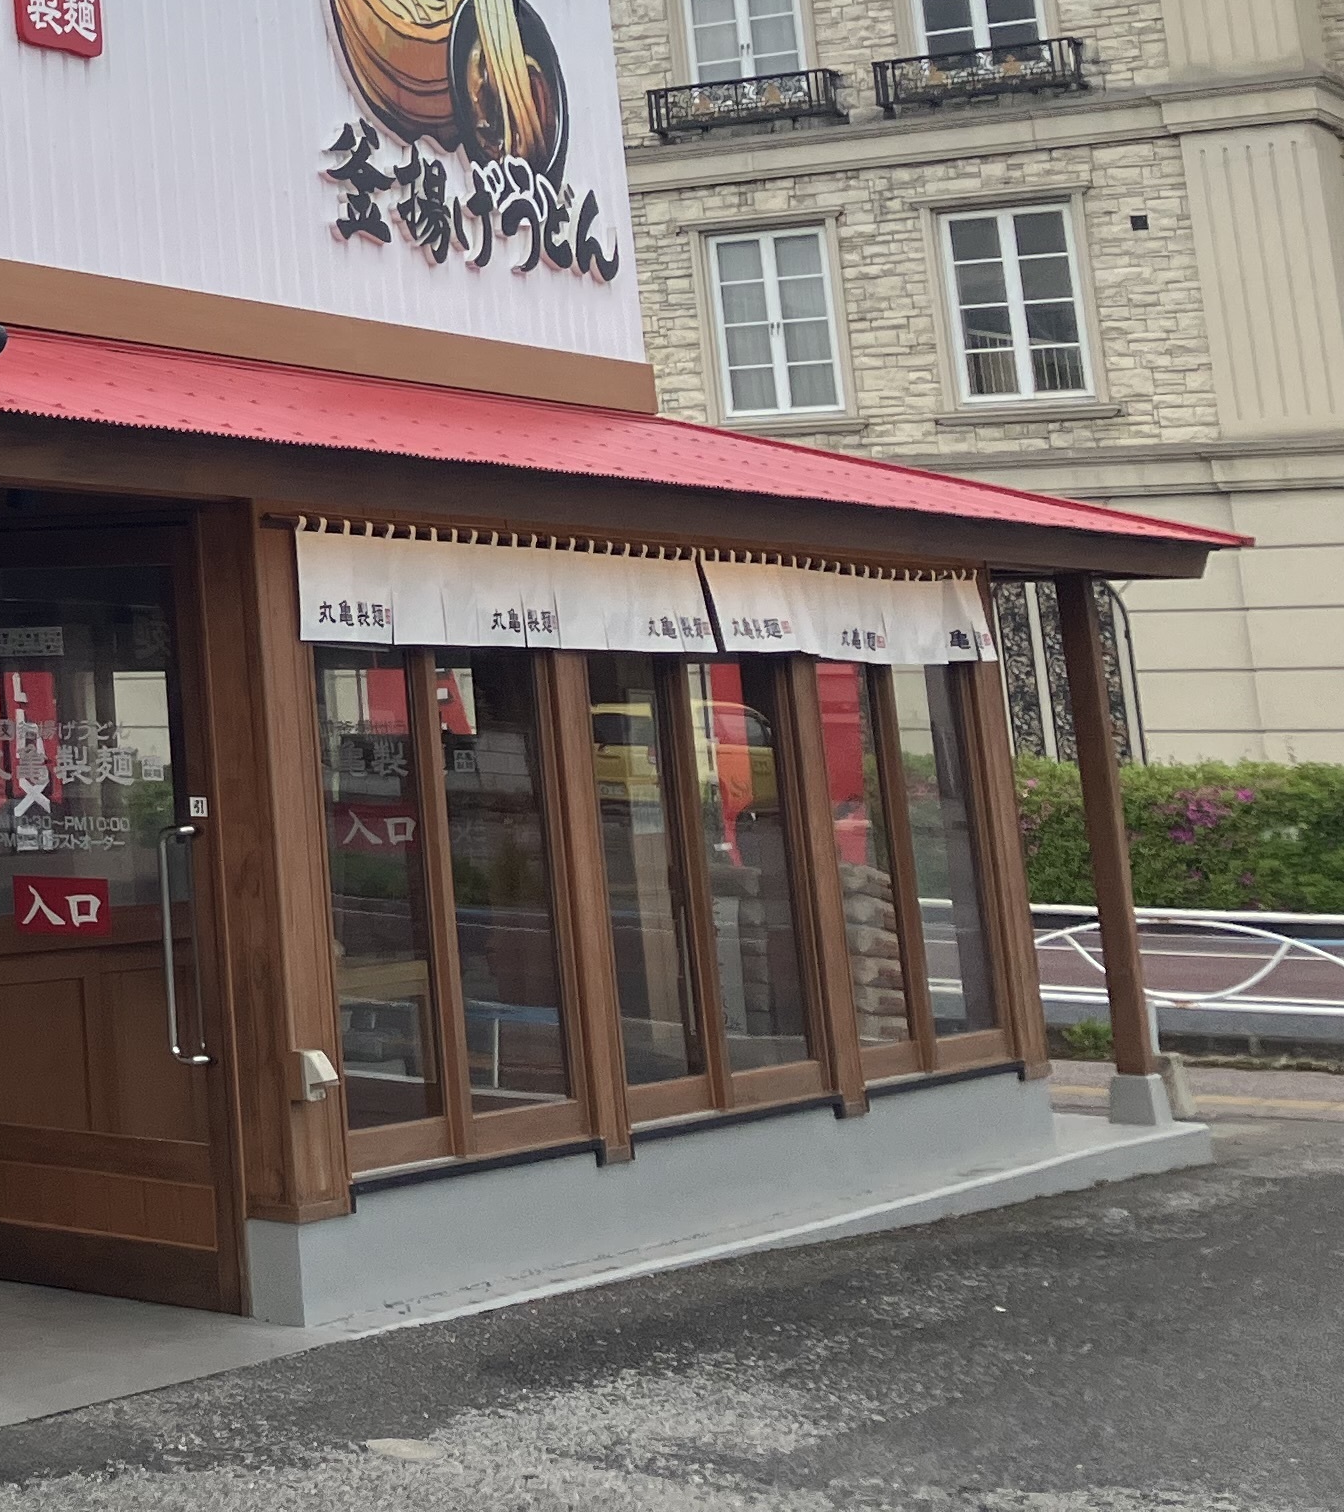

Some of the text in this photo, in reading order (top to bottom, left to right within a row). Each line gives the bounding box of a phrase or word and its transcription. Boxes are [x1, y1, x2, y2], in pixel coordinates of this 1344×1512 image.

[322, 118, 620, 281] 釜揚げうどん
[319, 599, 385, 628] 丸亀製麺
[491, 608, 553, 634] 丸亀製麺
[342, 809, 416, 846] 入口
[22, 885, 101, 928] 入口
